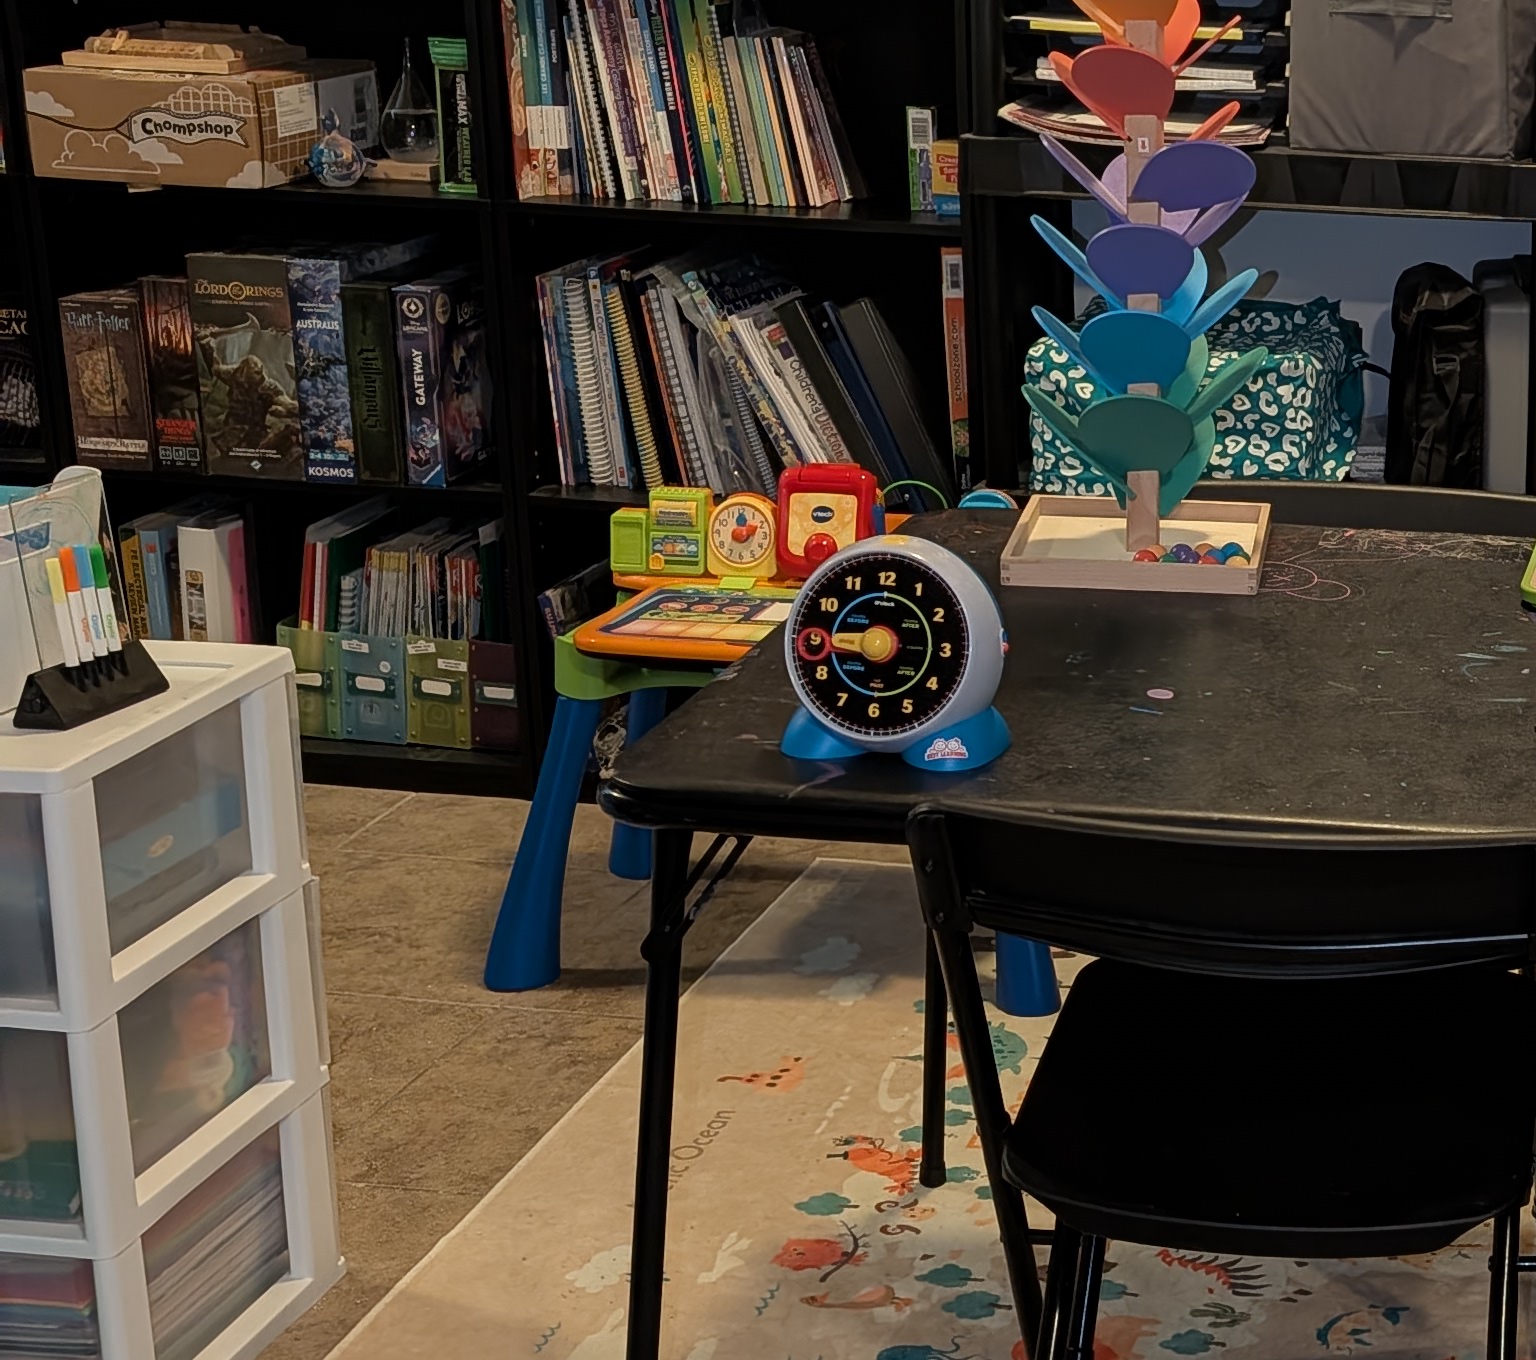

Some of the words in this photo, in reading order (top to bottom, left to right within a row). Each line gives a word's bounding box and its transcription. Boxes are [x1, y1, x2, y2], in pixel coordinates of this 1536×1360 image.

[141, 116, 234, 137] Chompshop
[296, 319, 339, 330] AUSTRALIS
[949, 316, 964, 402] schoolzone.com
[414, 348, 425, 406] GATEWAY
[308, 466, 354, 478] KOSMOS
[845, 576, 862, 590] 11
[878, 571, 897, 586] 12
[914, 582, 923, 597] 1
[819, 597, 838, 612] 10
[933, 608, 945, 622] 2
[809, 632, 822, 646] 9
[939, 643, 952, 657] 3
[815, 665, 828, 680] 8
[926, 677, 938, 690] 4
[836, 692, 848, 707] 7
[902, 699, 913, 713] 5
[868, 703, 880, 718] 6
